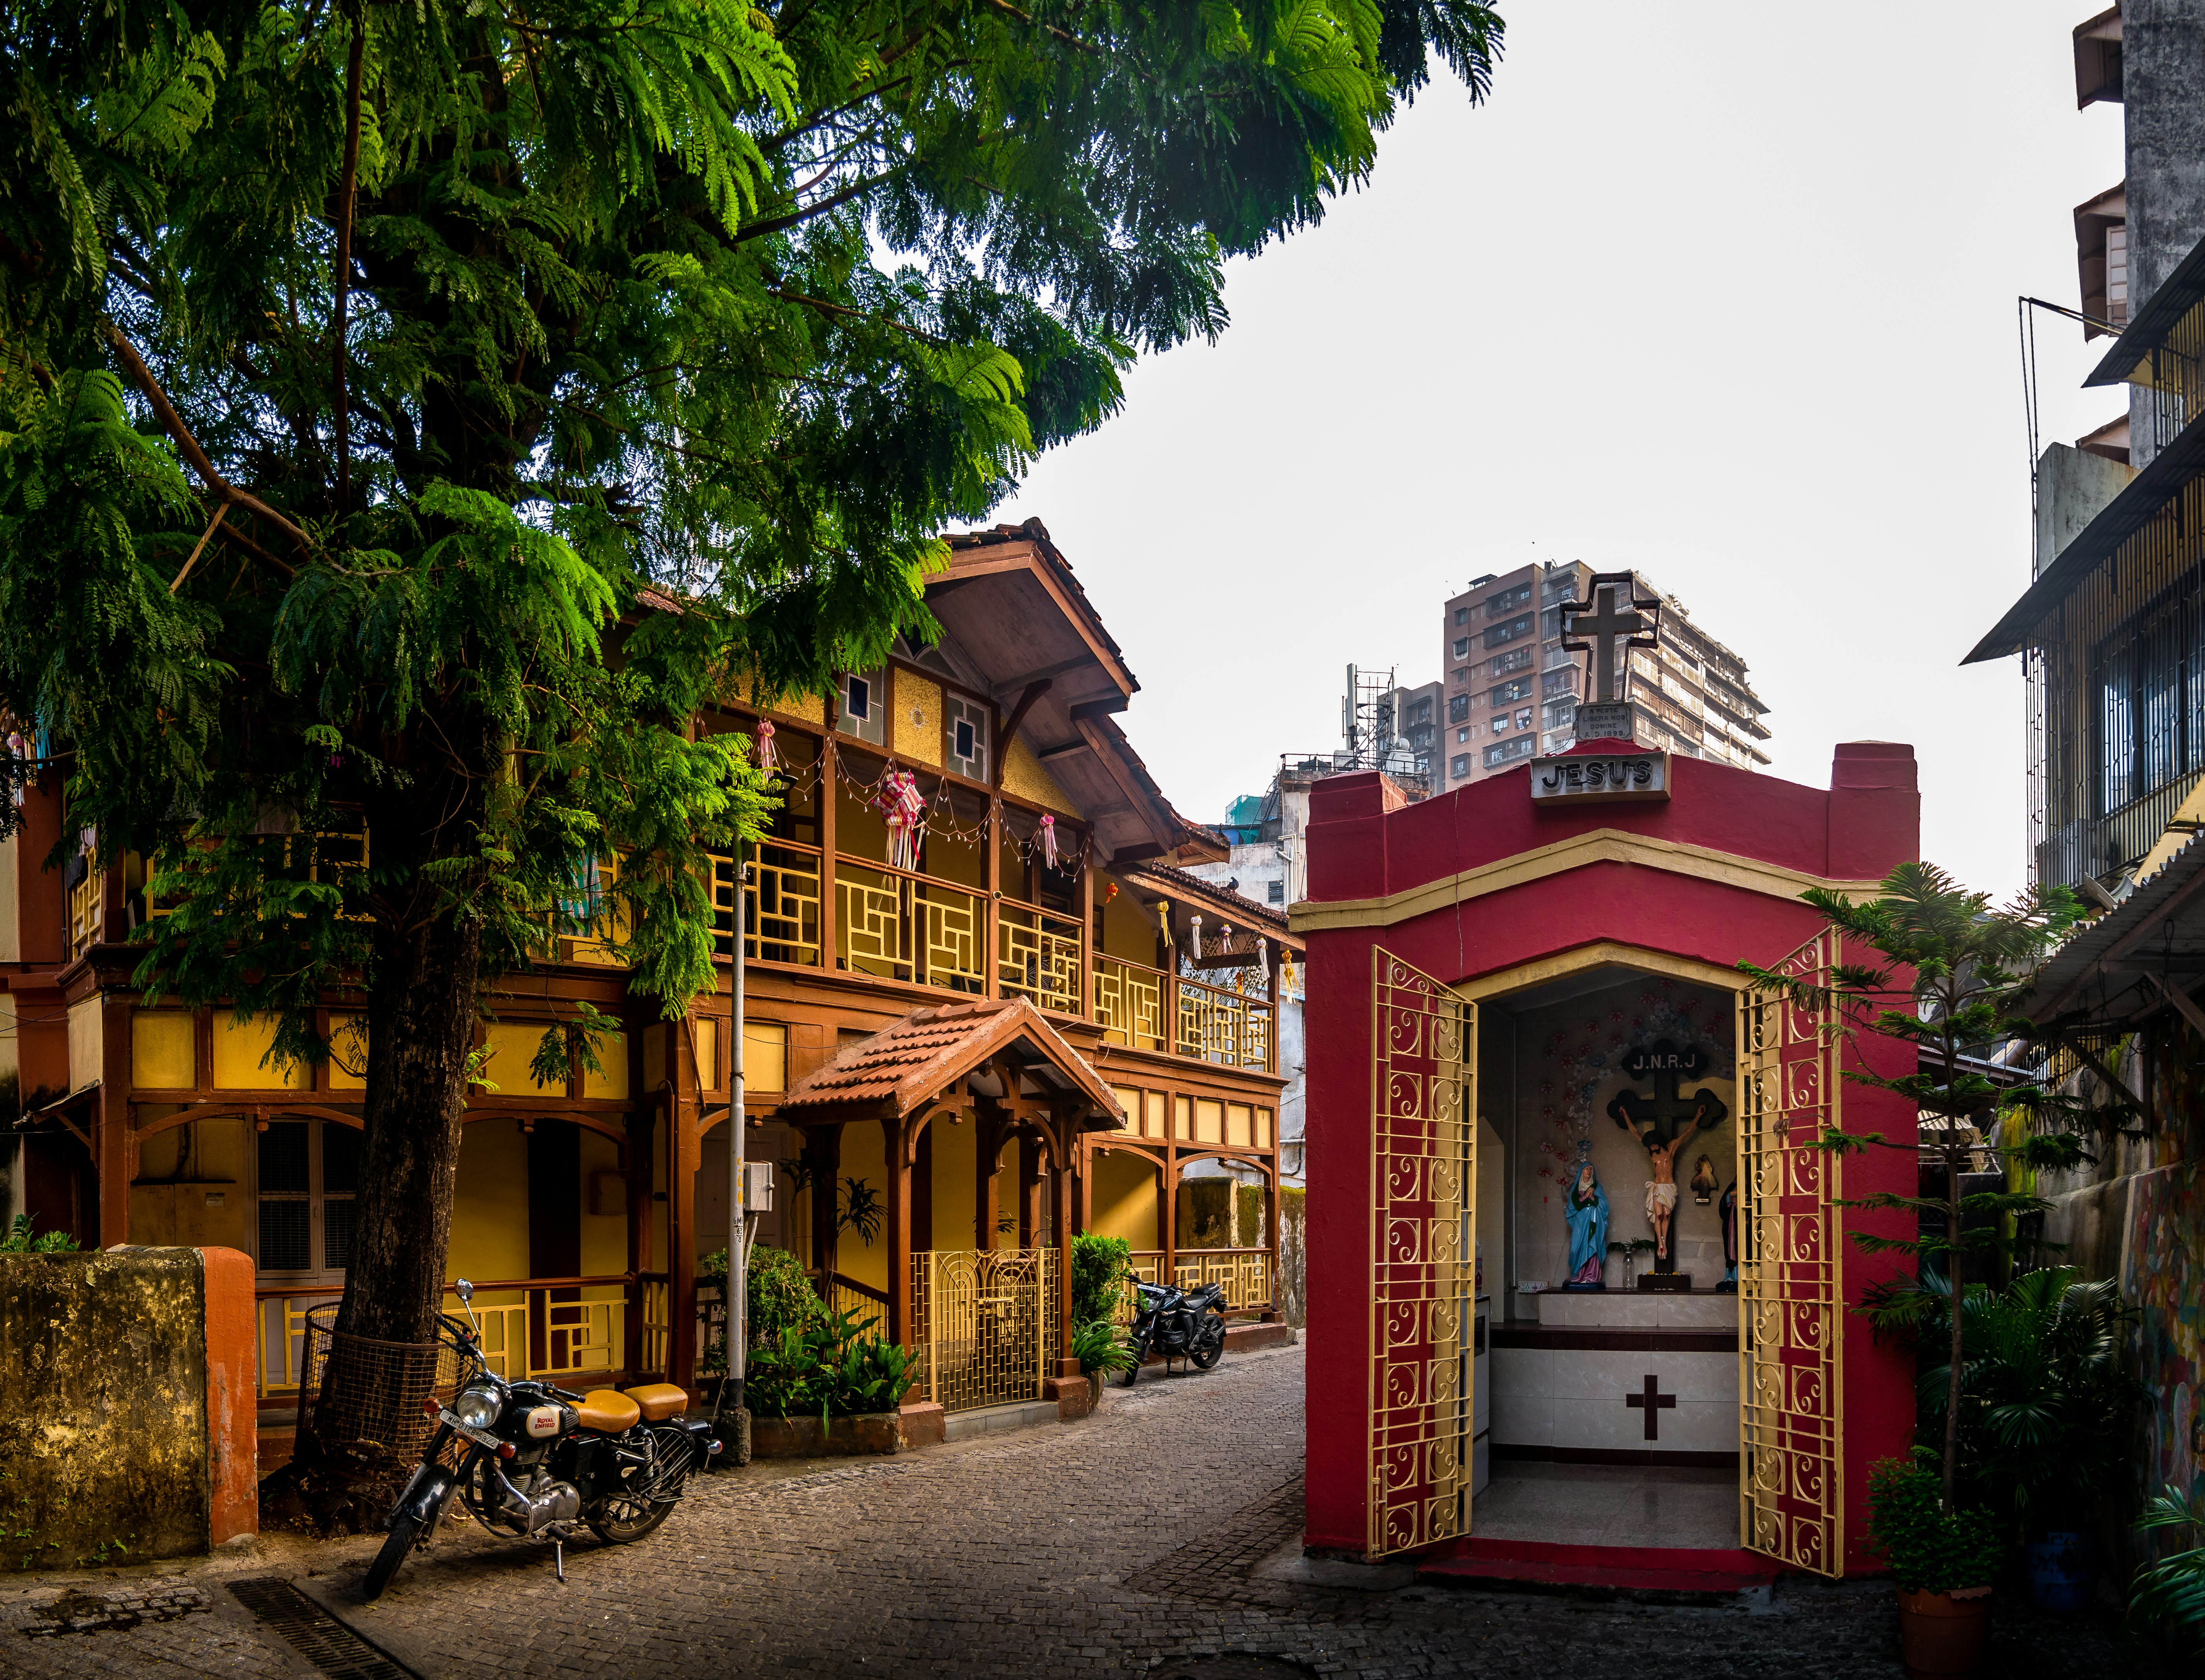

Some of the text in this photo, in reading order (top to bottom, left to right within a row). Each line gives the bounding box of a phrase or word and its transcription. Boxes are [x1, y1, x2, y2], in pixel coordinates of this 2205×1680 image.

[1541, 760, 1651, 789] JESUS
[1633, 1054, 1695, 1069] J.N.R.J
[447, 1415, 458, 1425] MH
